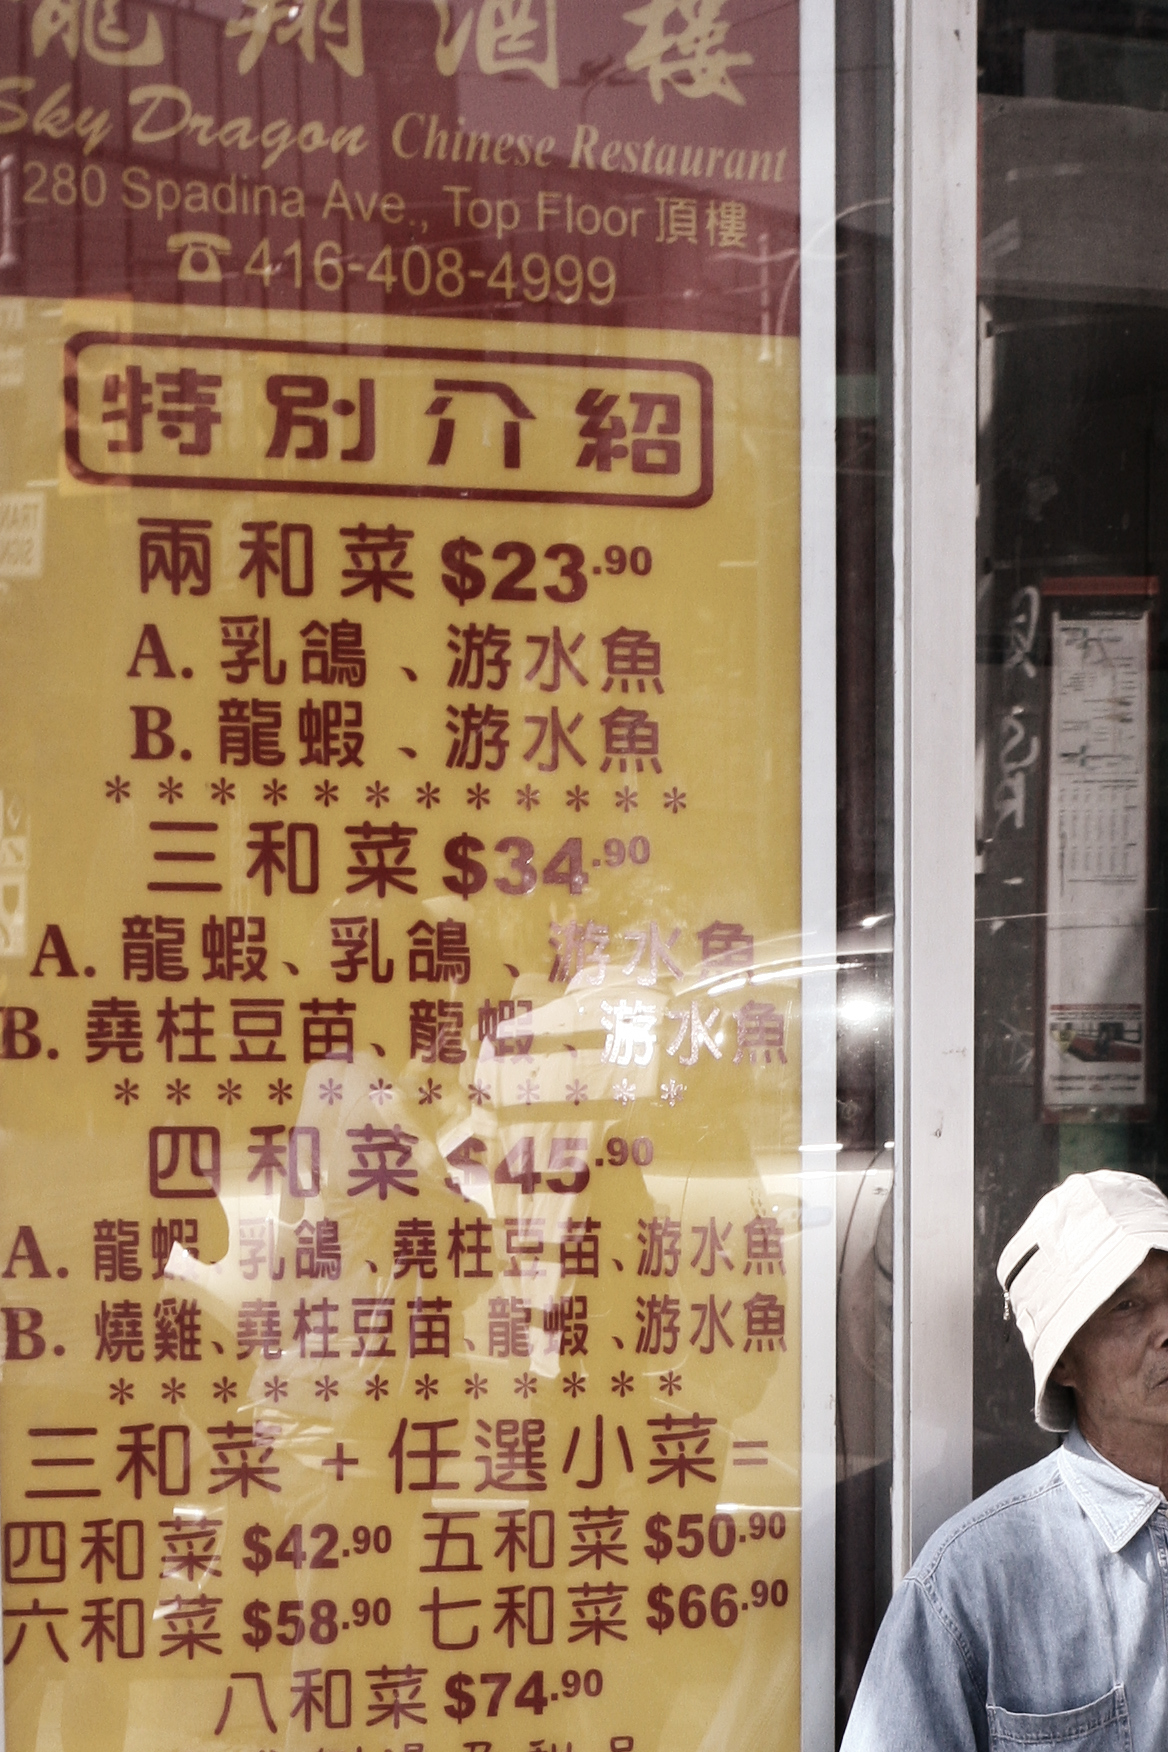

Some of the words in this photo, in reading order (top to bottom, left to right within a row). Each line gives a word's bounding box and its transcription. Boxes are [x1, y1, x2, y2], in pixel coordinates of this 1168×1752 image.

[0, 76, 113, 156] Sky
[128, 83, 369, 170] Dragon
[391, 112, 556, 168] Chinese
[569, 123, 789, 184] Restaurant
[23, 161, 107, 207] 280
[122, 166, 305, 220] Spadina
[322, 178, 429, 233] Ave.,
[443, 185, 520, 238] Top
[537, 191, 646, 237] Floor
[655, 197, 748, 249] 頂樓
[243, 238, 617, 306] 416-408-4999
[102, 365, 682, 477] 特別介紹
[137, 519, 415, 603] 兩和菜
[440, 536, 653, 606] $23.90
[126, 623, 194, 680] A.
[129, 705, 193, 761] B.
[147, 820, 419, 898] 三和菜
[442, 832, 652, 901] $34.90
[29, 923, 97, 978] A.
[0, 1006, 59, 1060] B.
[148, 1123, 420, 1200] 四和菜
[1, 1225, 69, 1279] A.
[1, 1306, 66, 1361] B.
[3, 1515, 223, 1584] 四和菜
[242, 1523, 392, 1577] $42.90
[419, 1505, 628, 1575] 五和菜
[643, 1509, 787, 1562] $50.90
[3, 1593, 223, 1664] 六和菜
[242, 1597, 392, 1652] $58.90
[419, 1581, 628, 1652] 七和菜
[645, 1579, 789, 1634] $66.90
[213, 1663, 428, 1736] 八和菜
[443, 1667, 604, 1724] $74.90
